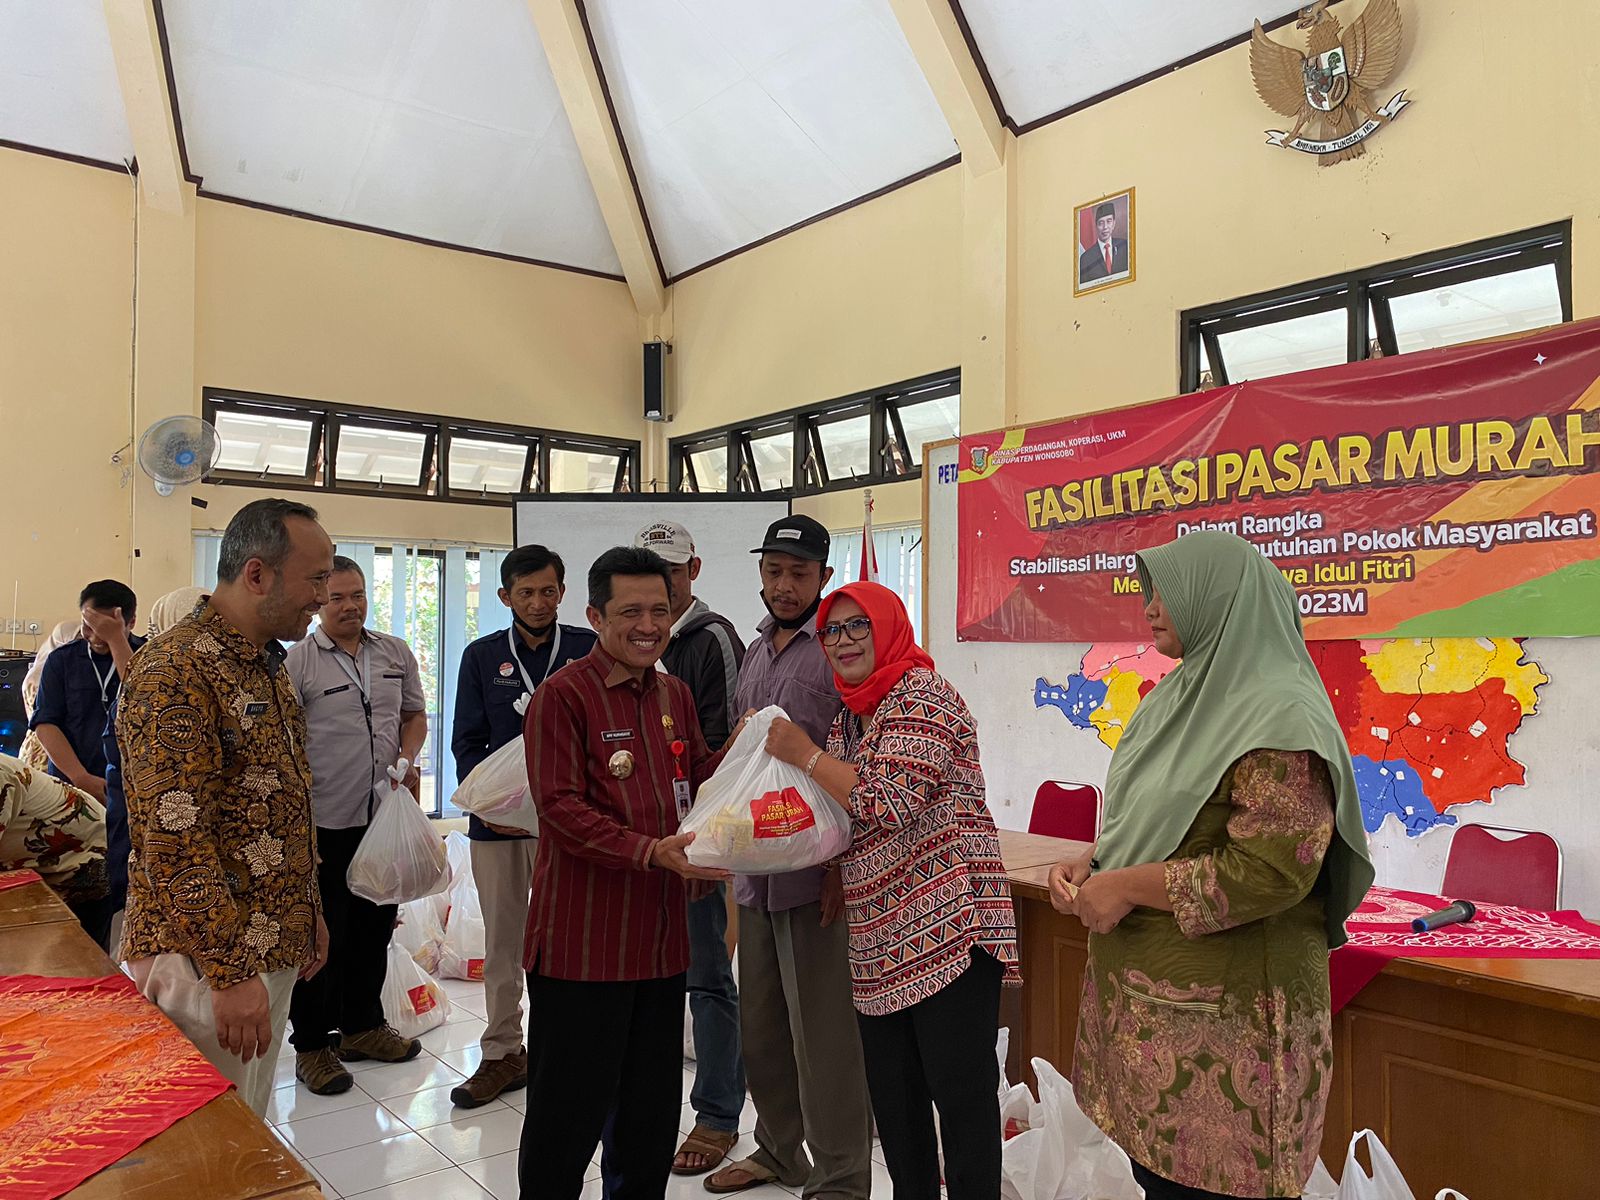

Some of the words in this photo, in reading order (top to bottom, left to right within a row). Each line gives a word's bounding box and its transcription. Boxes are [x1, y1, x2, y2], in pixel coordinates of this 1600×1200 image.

[1015, 440, 1068, 455] PERDAGANGAN,
[1069, 434, 1106, 447] KOPERASI,
[1106, 429, 1127, 441] UKM
[991, 455, 1034, 465] KABUPATEN
[1034, 448, 1075, 461] WONOSOBO
[1025, 457, 1209, 529] FASILITASI
[1216, 434, 1372, 500] PASAR
[1383, 413, 1600, 481] MURAH
[1242, 511, 1322, 537] Rangka
[1009, 554, 1092, 576] Stabilisasi
[1095, 553, 1137, 573] Harg
[1343, 527, 1416, 552] Pokok
[1423, 512, 1593, 550] Masyarakat
[1314, 560, 1356, 583] Idul
[1363, 557, 1412, 580] Fitri
[1298, 592, 1365, 614] 023M
